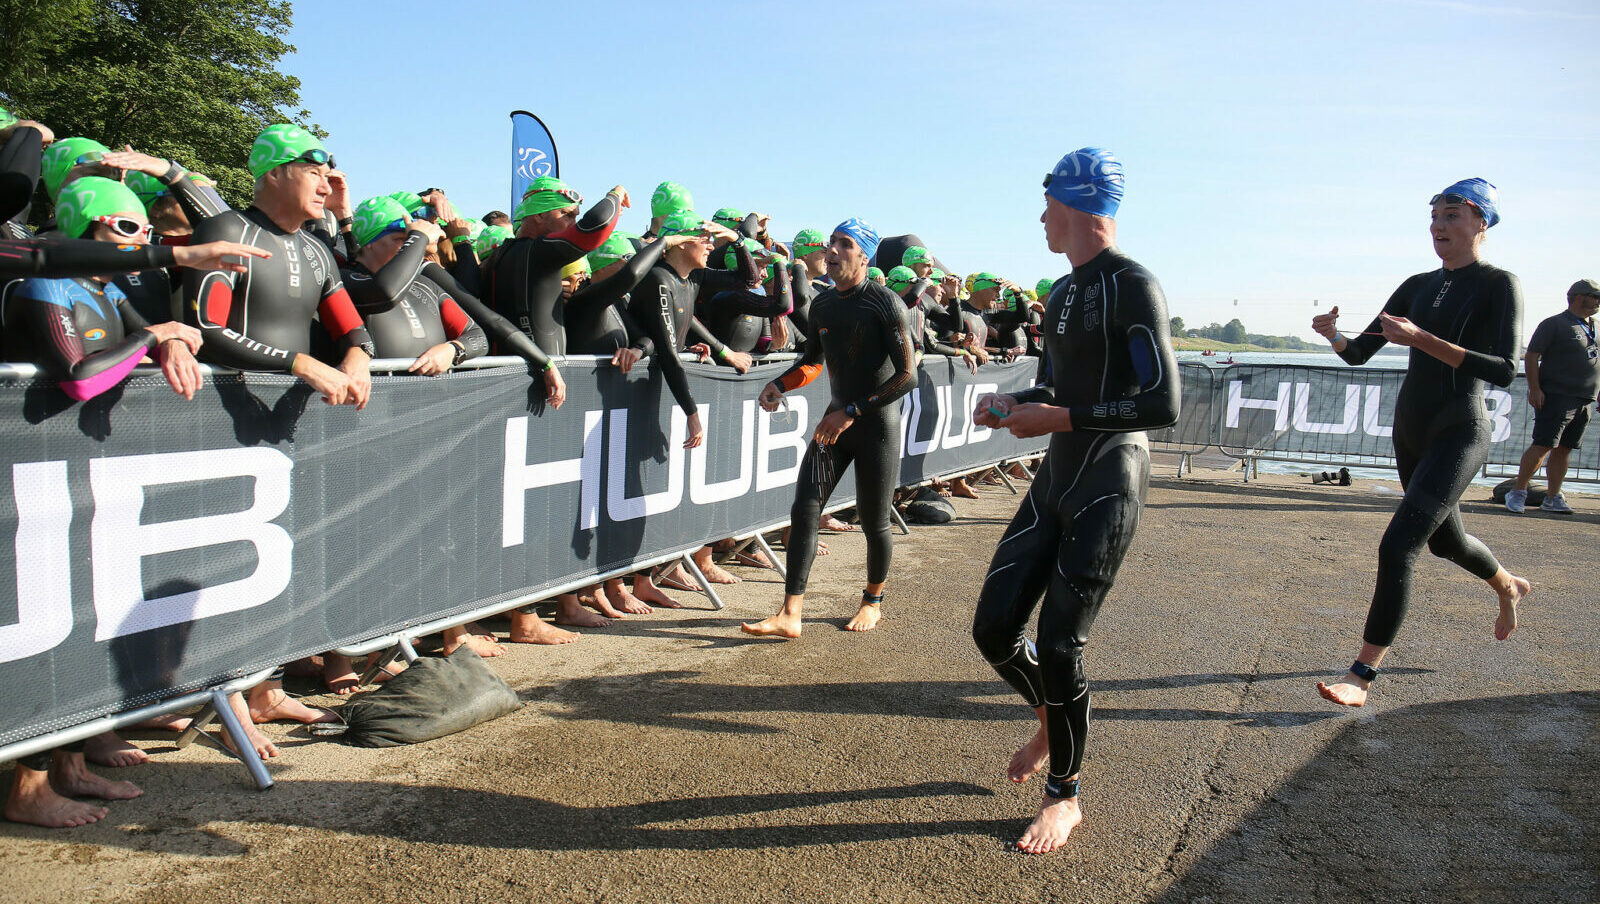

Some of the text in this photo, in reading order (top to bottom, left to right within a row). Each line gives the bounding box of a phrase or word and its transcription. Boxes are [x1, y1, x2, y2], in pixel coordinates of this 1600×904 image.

[284, 240, 300, 287] HUUB
[400, 299, 422, 329] UUB
[1057, 284, 1077, 334] HUUB
[1433, 281, 1452, 307] HUUB
[901, 383, 999, 458] UUB
[502, 395, 808, 548] HUUB
